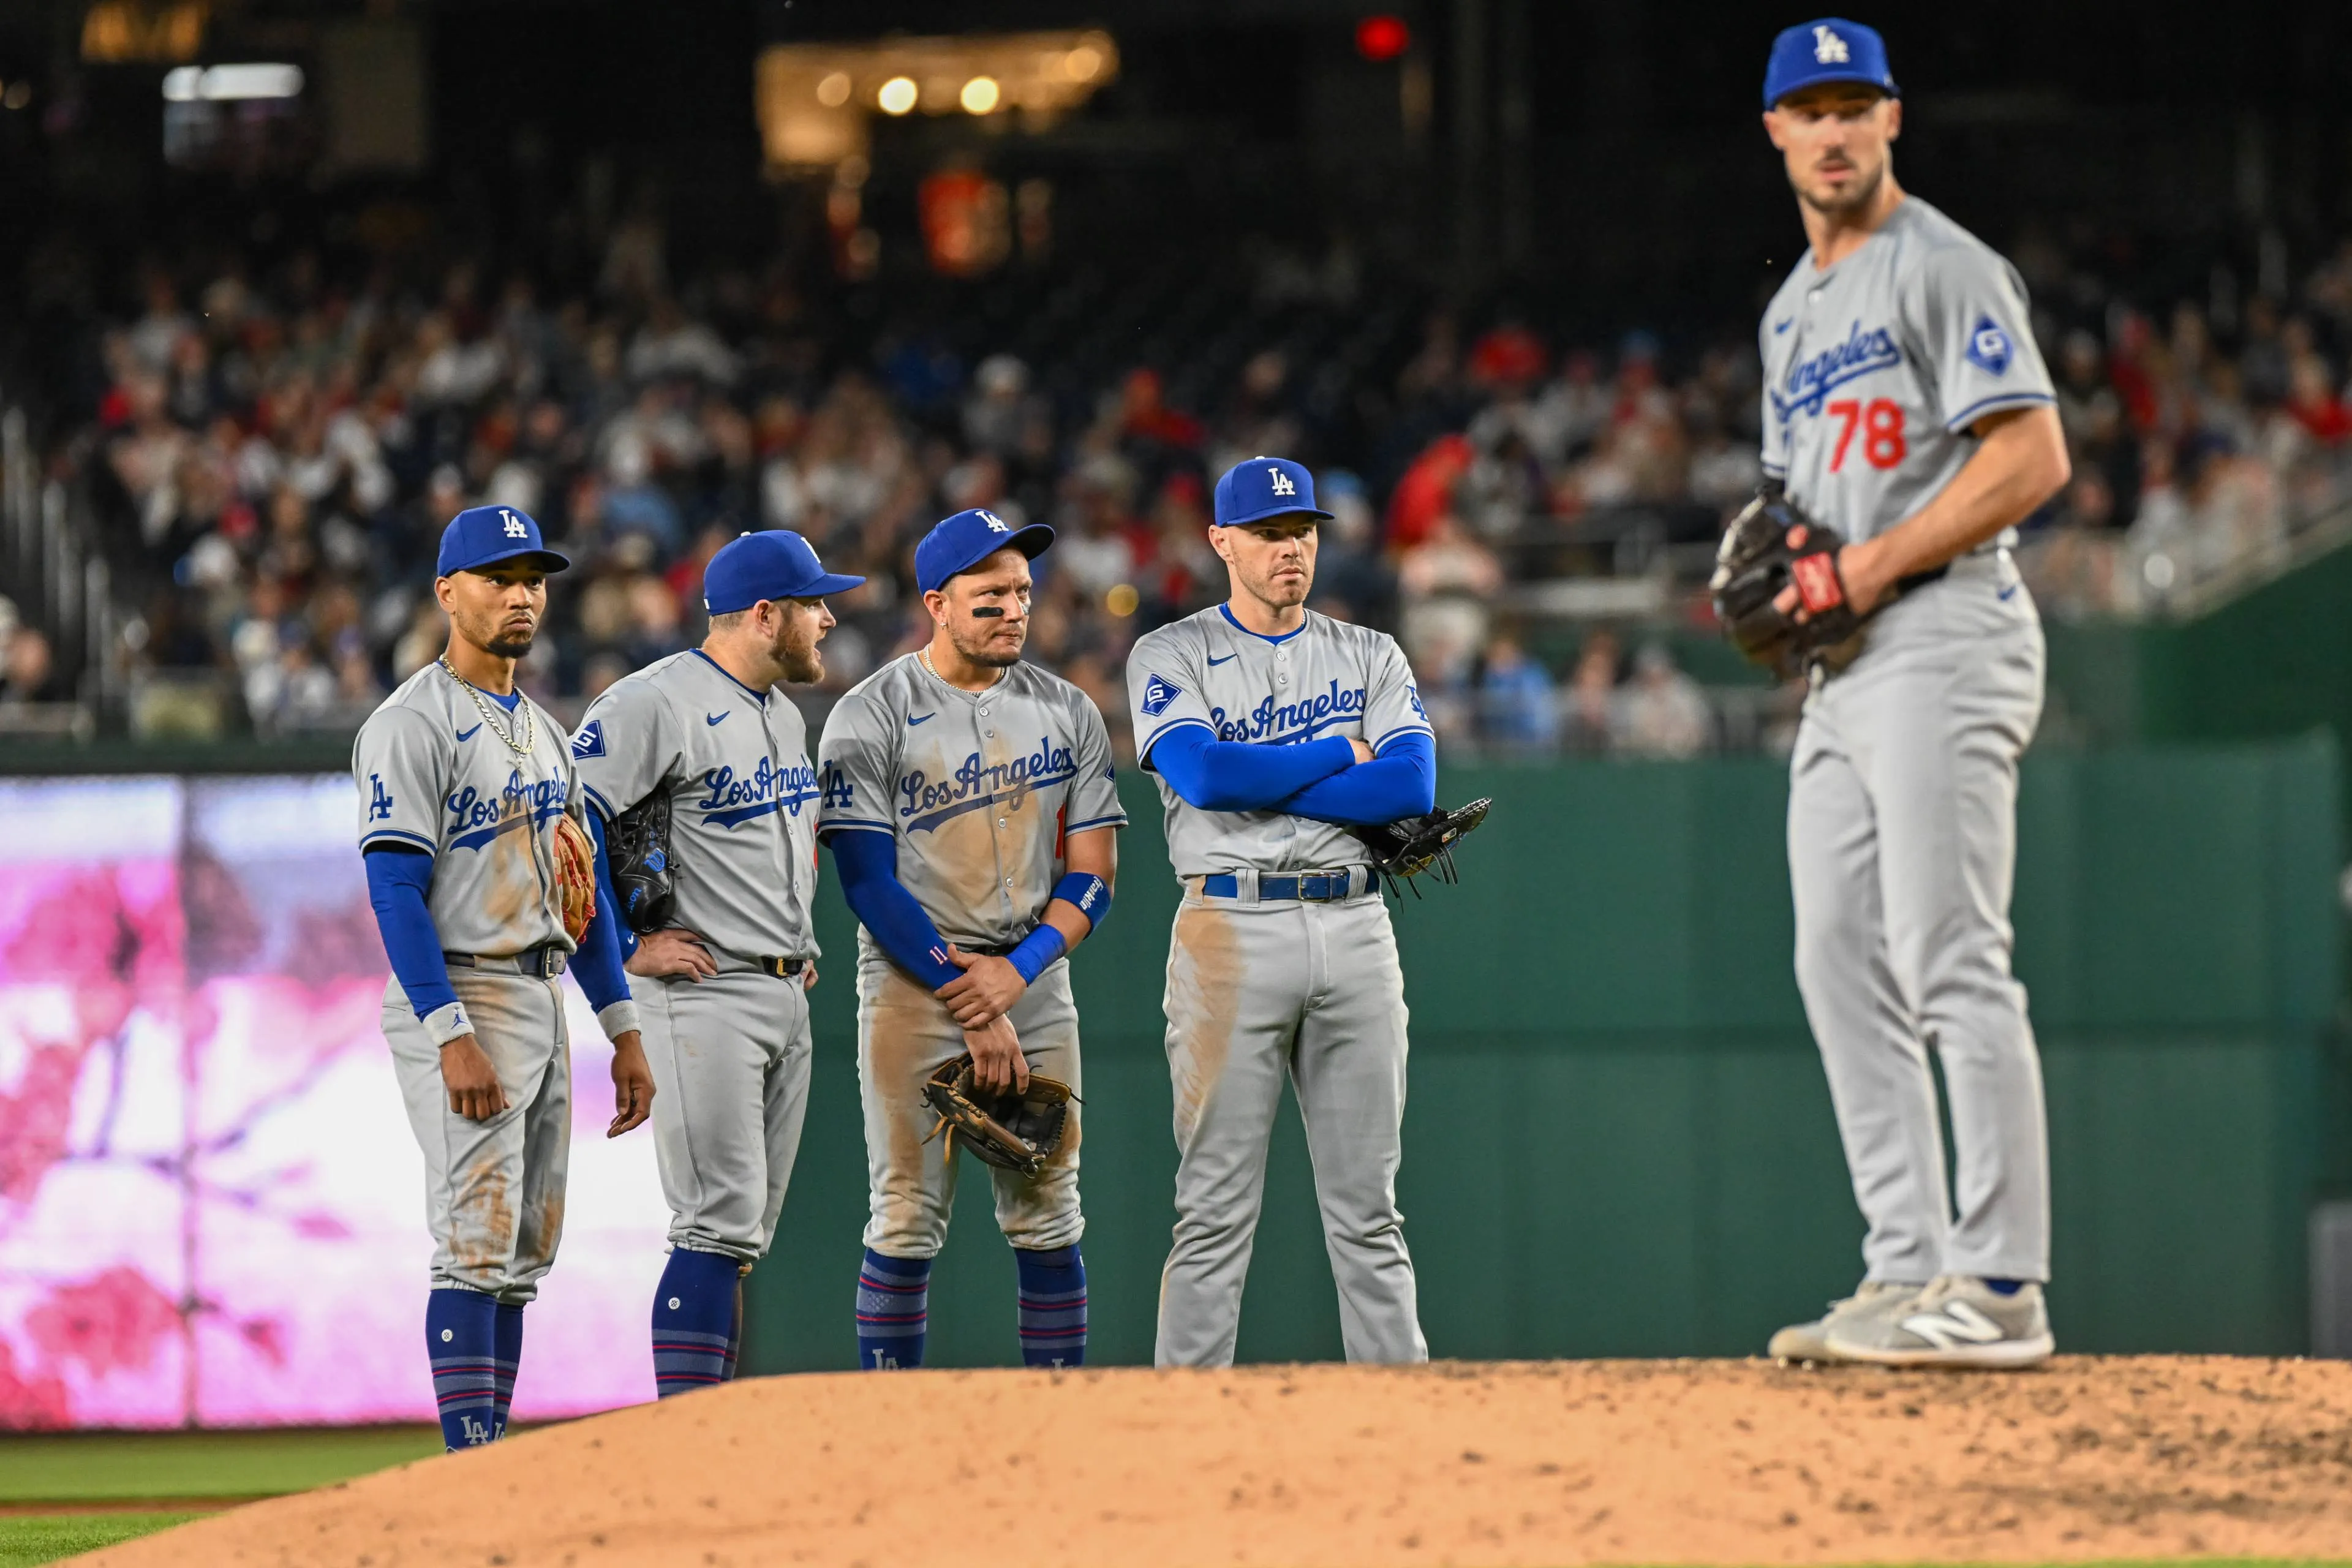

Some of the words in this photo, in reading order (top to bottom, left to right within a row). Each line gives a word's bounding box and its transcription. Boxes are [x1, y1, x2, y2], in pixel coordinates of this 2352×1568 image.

[1812, 24, 1852, 64] LA
[1787, 318, 1899, 417] ngeles
[1826, 397, 1908, 474] 78
[1268, 467, 1295, 496] LA
[499, 510, 528, 538] LA
[975, 511, 1009, 533] LA
[1250, 678, 1366, 744] Angeles
[369, 772, 393, 823] LA
[699, 766, 754, 810] Los
[824, 759, 853, 810] LA
[900, 770, 953, 817] Los
[952, 736, 1076, 812] Angeles
[447, 786, 499, 835] Los
[500, 766, 567, 834] Angele
[930, 946, 948, 965] 11
[461, 1415, 488, 1446] LA
